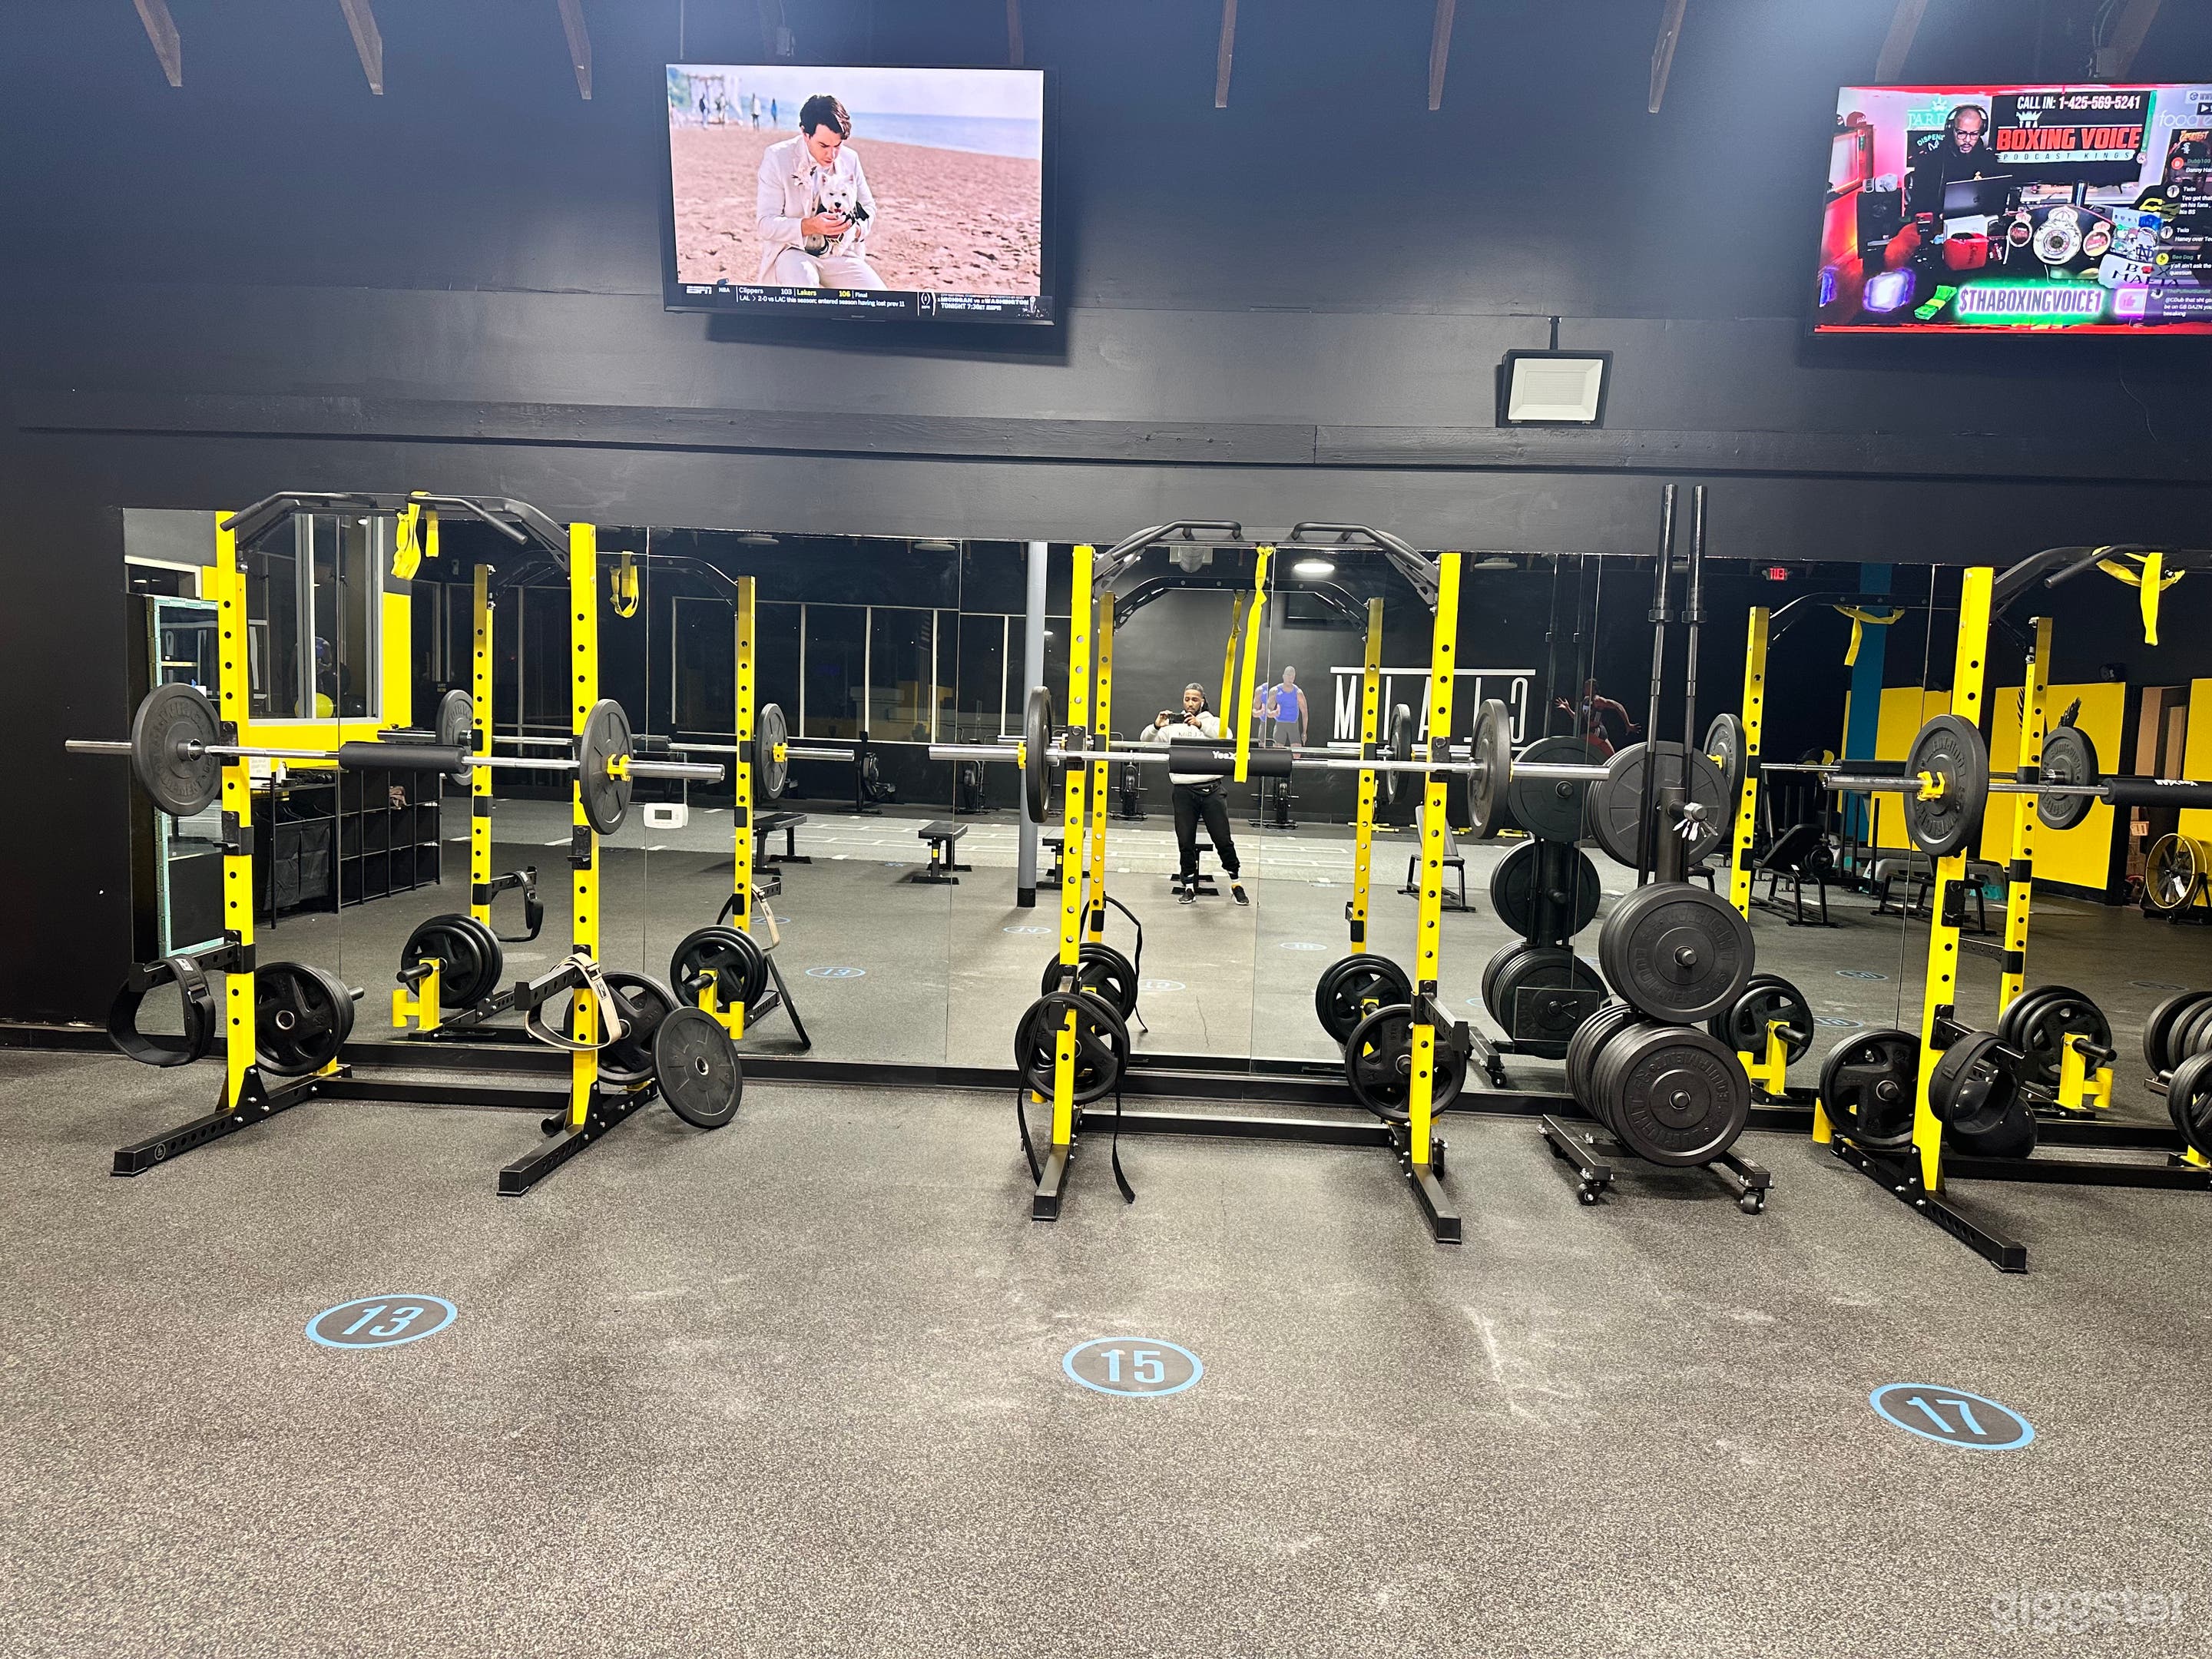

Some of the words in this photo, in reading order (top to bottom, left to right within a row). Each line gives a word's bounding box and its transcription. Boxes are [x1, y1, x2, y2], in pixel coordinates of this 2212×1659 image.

[2016, 95, 2041, 109] CALL
[2041, 95, 2056, 109] IN:
[2058, 94, 2141, 110] 1-425-569-5241
[1996, 127, 2076, 151] BOXING
[2080, 127, 2144, 150] VOICE
[739, 286, 764, 295] Clippers
[838, 290, 851, 298] 106
[858, 299, 876, 307] having
[1959, 287, 2102, 313] $THABOXINGVOICE1
[342, 1305, 425, 1336] 13
[1100, 1349, 1165, 1383] 15
[1905, 1396, 1988, 1435] 17
